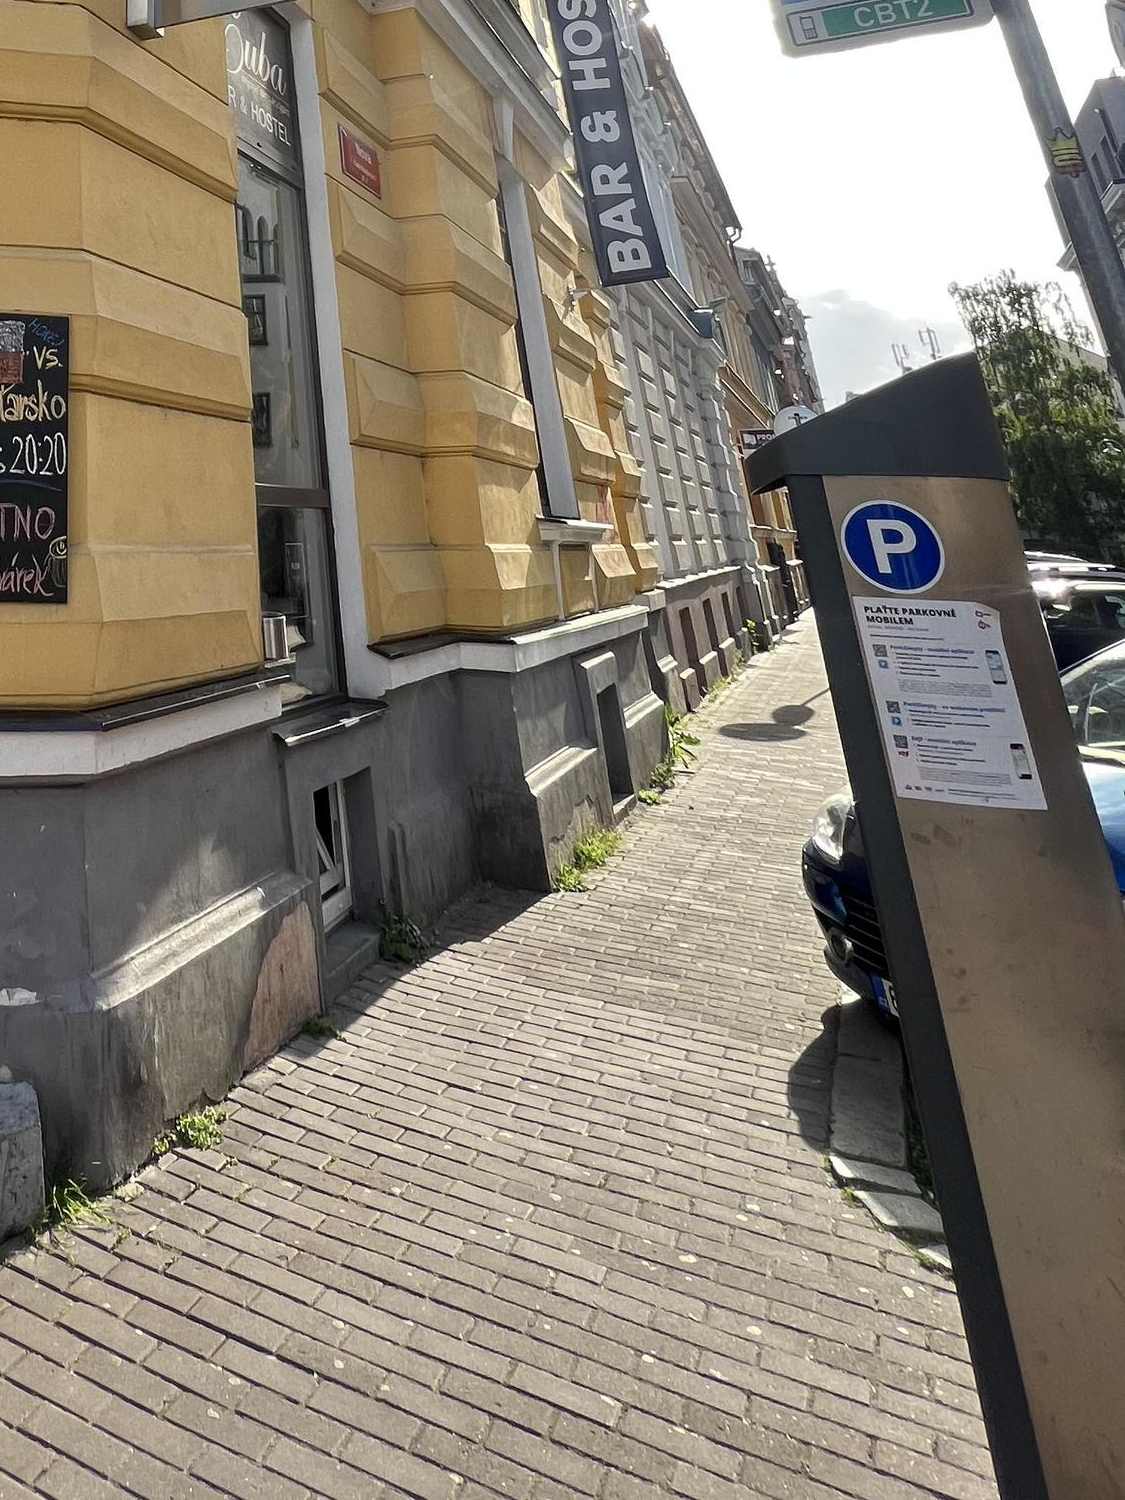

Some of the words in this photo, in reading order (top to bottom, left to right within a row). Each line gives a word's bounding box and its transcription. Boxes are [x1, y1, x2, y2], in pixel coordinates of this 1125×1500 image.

[251, 101, 292, 147] HOSTEL
[581, 110, 621, 143] &
[590, 161, 651, 274] BAR
[867, 519, 917, 574] P
[866, 616, 914, 625] MOBILEM
[902, 607, 957, 618] PARKOVNÉ
